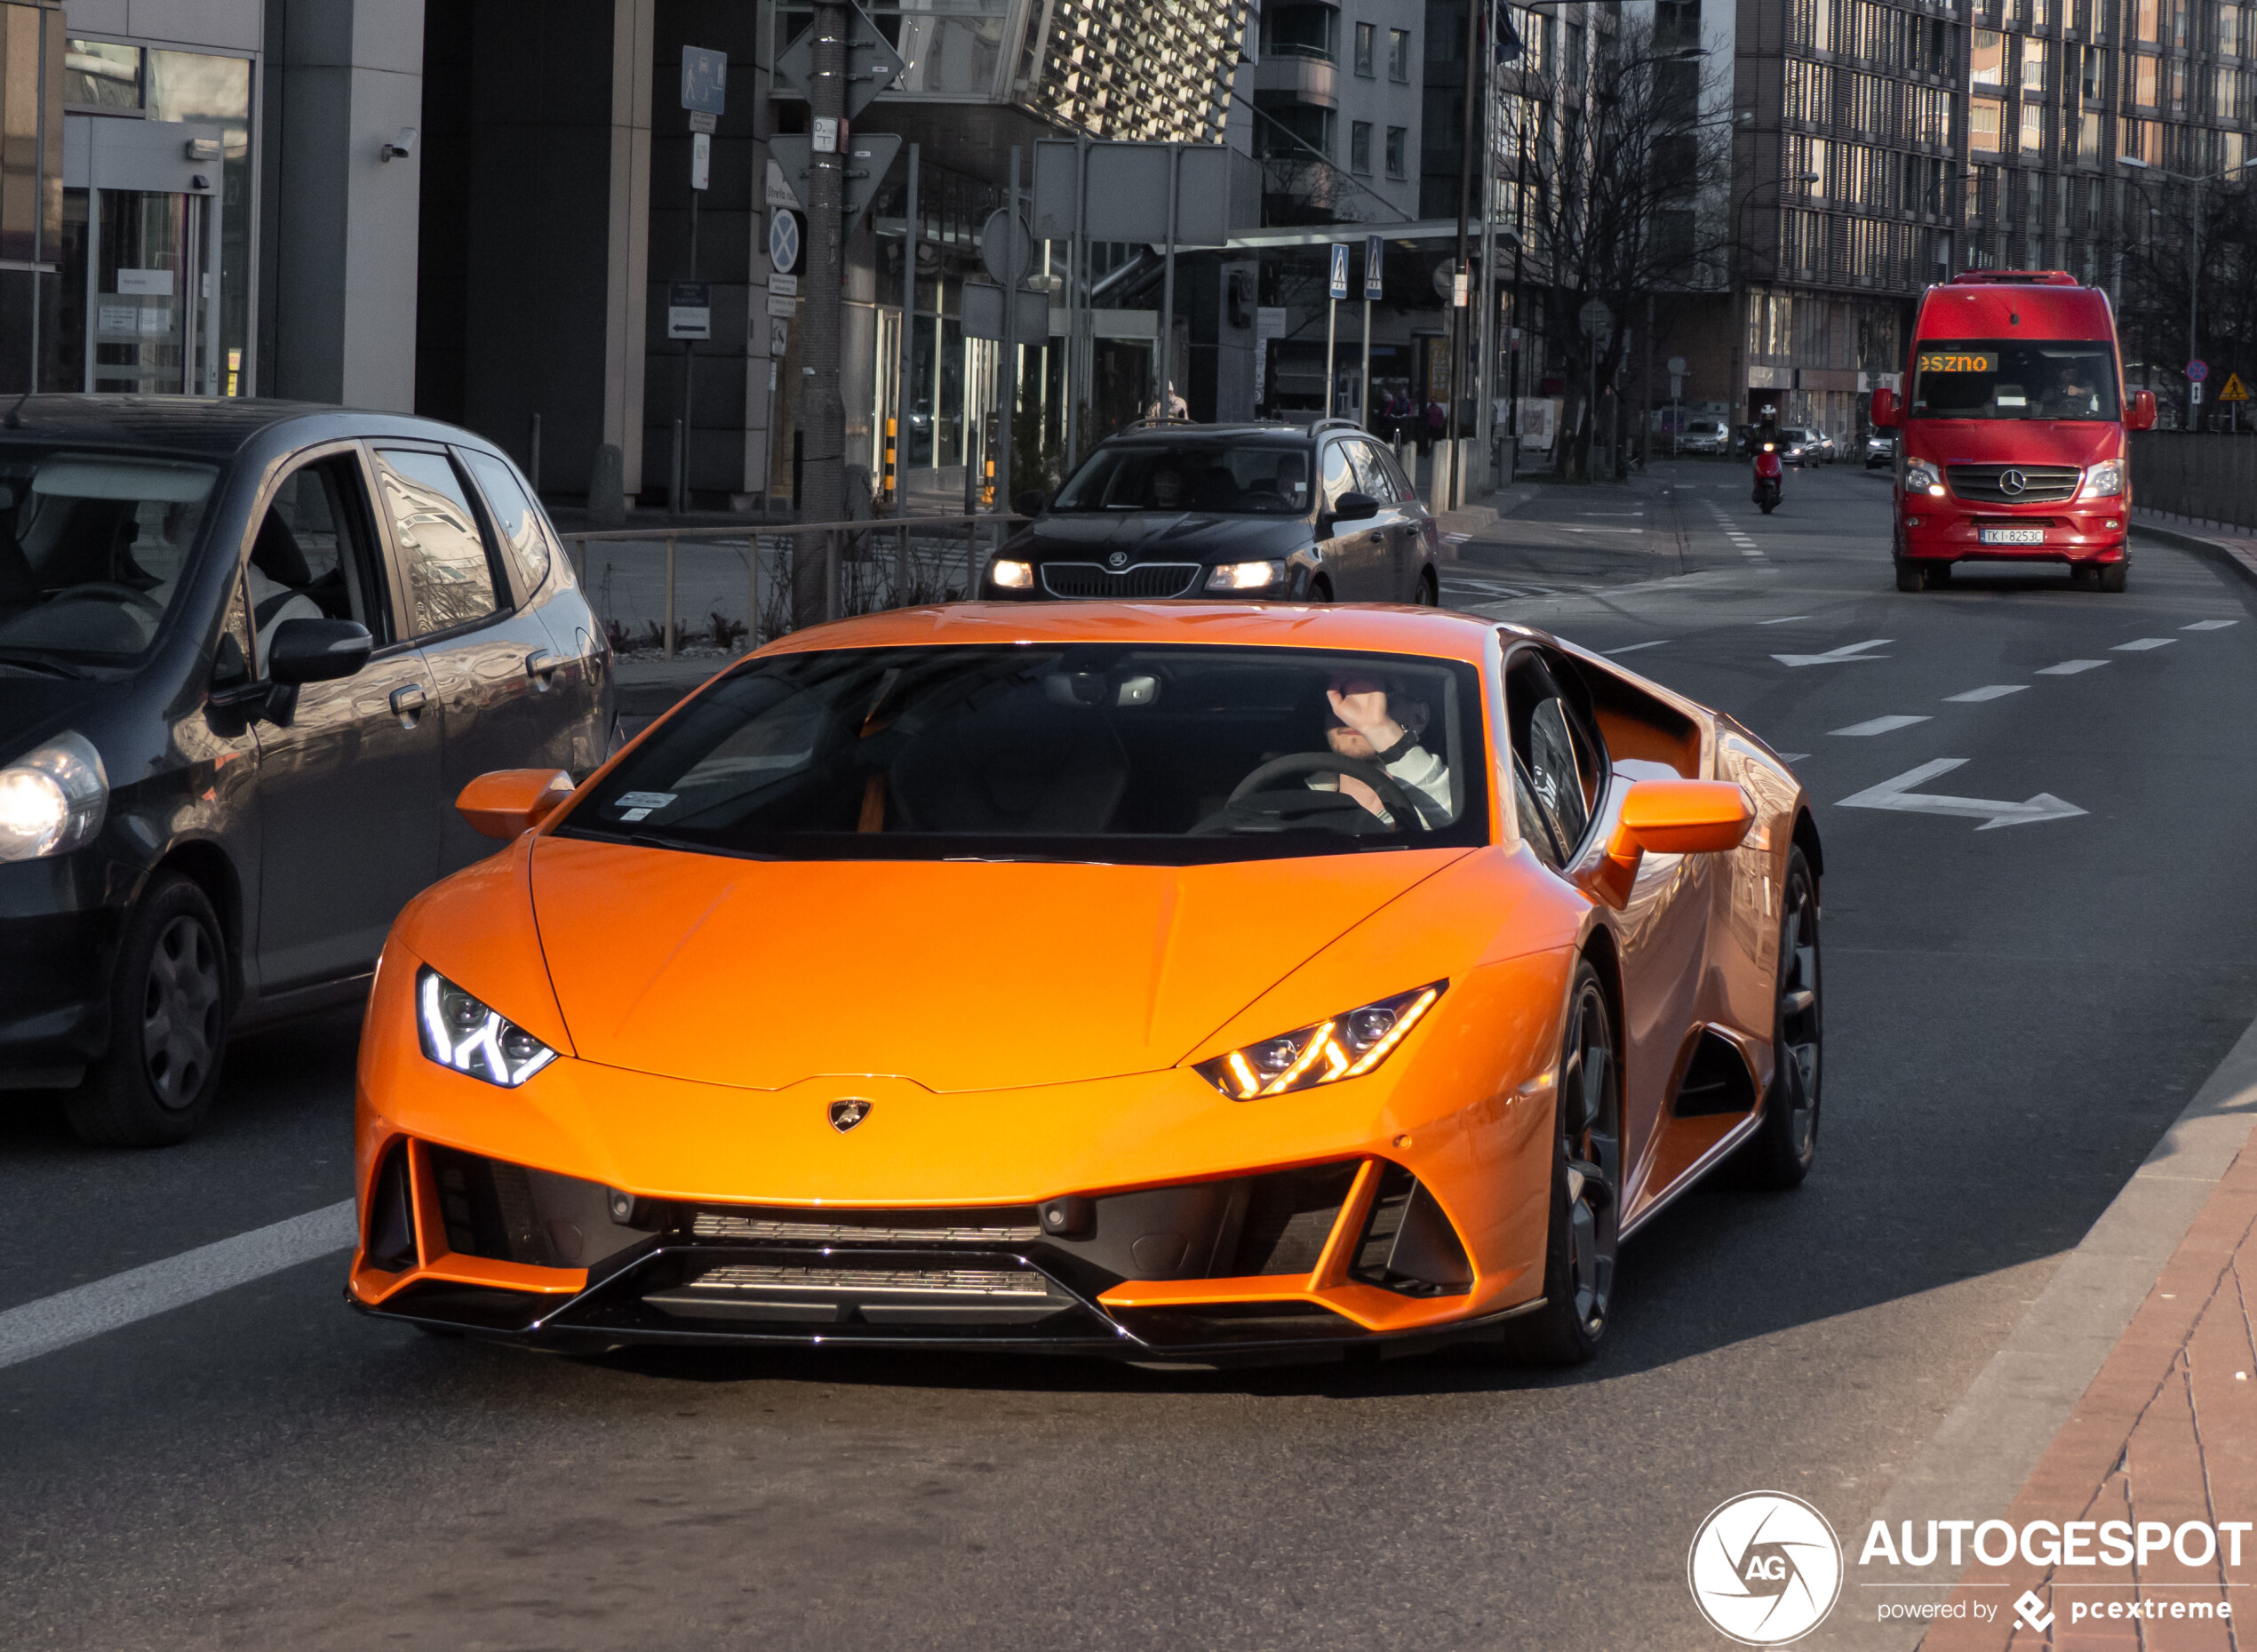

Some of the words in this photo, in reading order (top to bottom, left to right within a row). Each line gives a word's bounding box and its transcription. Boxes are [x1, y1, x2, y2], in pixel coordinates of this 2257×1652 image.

[768, 186, 786, 200] Strefa
[1986, 531, 2004, 541] TKI
[2009, 531, 2041, 541] 8253C
